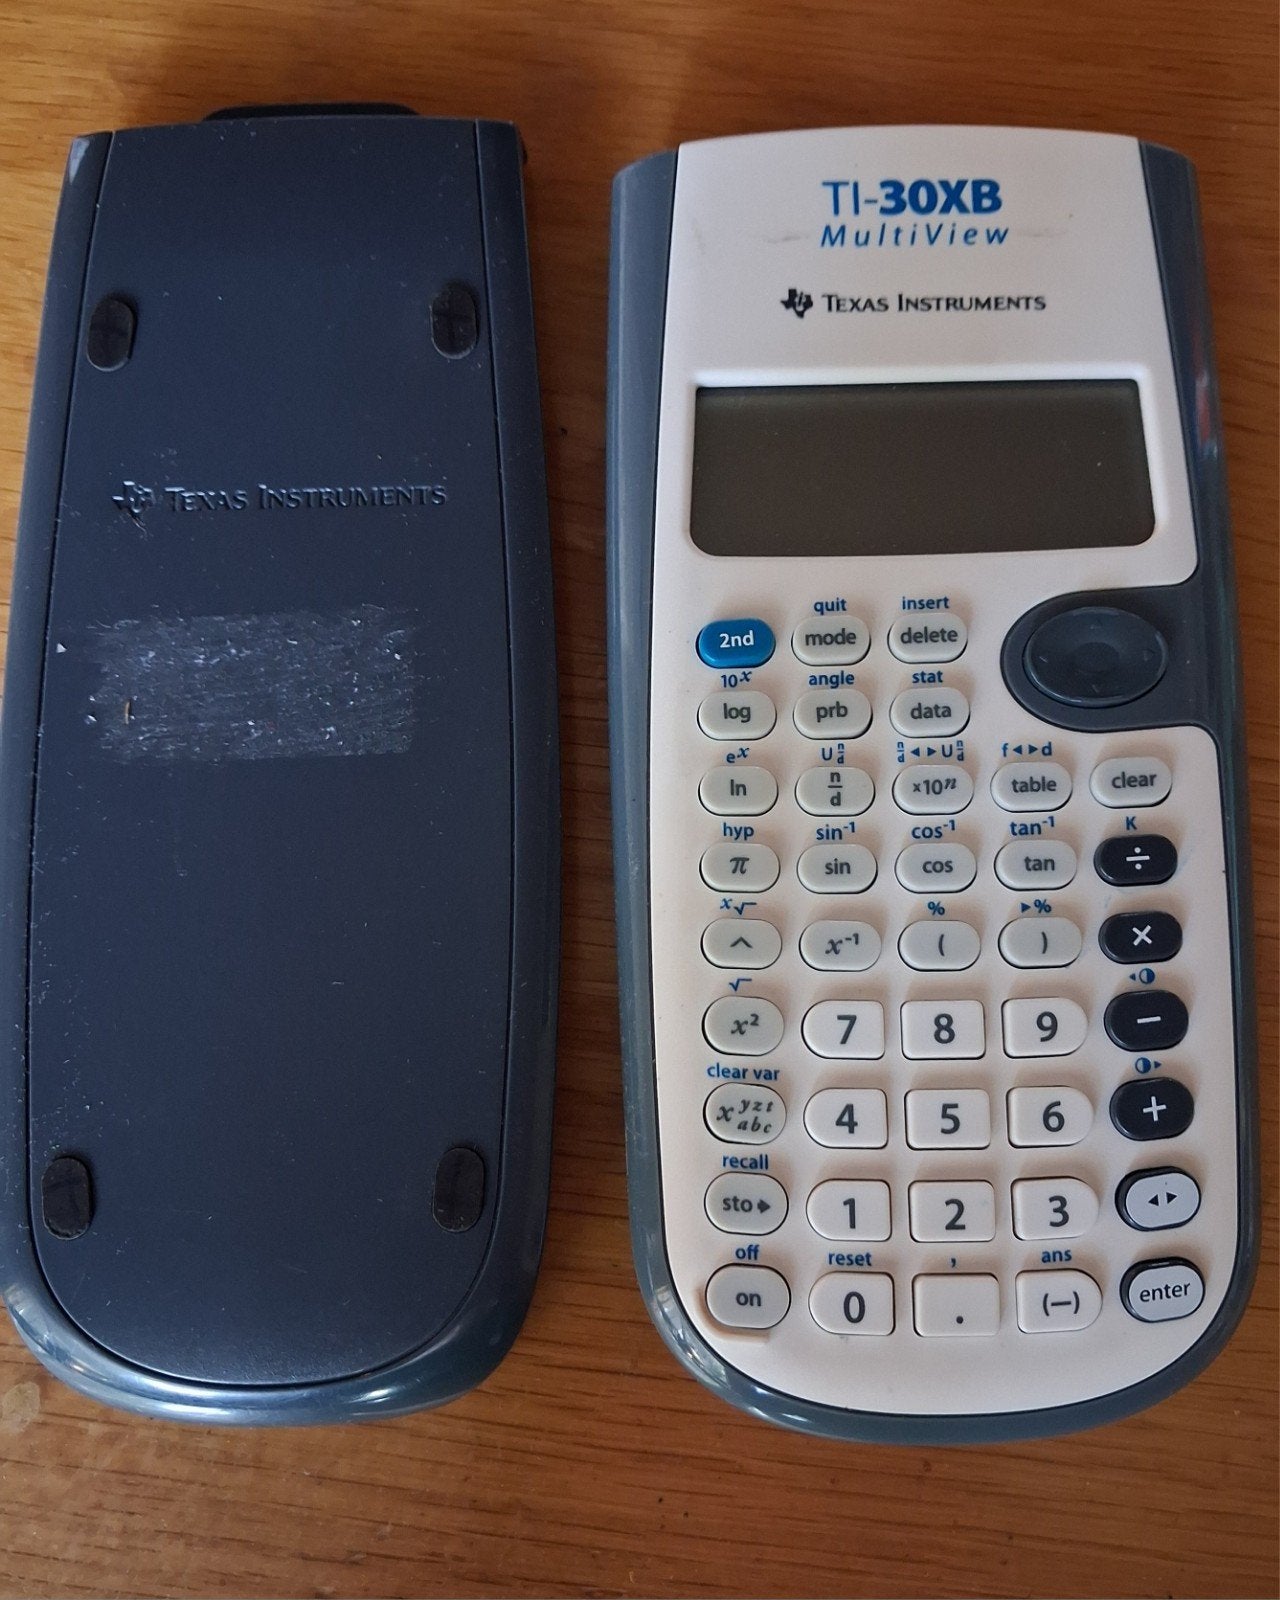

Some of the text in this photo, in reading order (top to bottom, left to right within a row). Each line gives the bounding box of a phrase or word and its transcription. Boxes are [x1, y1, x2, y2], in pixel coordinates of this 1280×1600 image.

[822, 178, 1003, 217] TI-30XB
[819, 223, 1010, 248] MultiView
[813, 598, 847, 614] quit
[901, 597, 950, 610] insert
[719, 631, 755, 647] 2nd
[805, 630, 857, 646] mode
[900, 627, 958, 644] delete
[808, 672, 855, 688] angle
[911, 671, 943, 684] stat
[723, 704, 751, 722] log
[816, 702, 848, 722] prb
[910, 703, 952, 719] data
[1011, 777, 1057, 792] table
[1111, 772, 1157, 788] clear
[1125, 817, 1137, 830] K
[722, 823, 754, 841] hyp
[825, 860, 851, 874] sin
[922, 860, 953, 874] cos
[1024, 856, 1055, 871] tan
[836, 1015, 857, 1044] 7
[933, 1014, 955, 1044] 8
[1037, 1011, 1058, 1042] 9
[707, 1063, 780, 1080] clear var
[835, 1104, 858, 1134] 4
[940, 1103, 961, 1134] 5
[1042, 1101, 1065, 1132] 6
[722, 1154, 769, 1170] recall
[843, 1198, 857, 1229] 1
[944, 1199, 965, 1230] 2
[1049, 1195, 1069, 1227] 3
[735, 1245, 759, 1260] off
[828, 1251, 872, 1267] reset
[1041, 1248, 1072, 1263] ans
[736, 1292, 761, 1306] on
[1140, 1281, 1191, 1302] enter
[843, 1291, 866, 1323] 0
